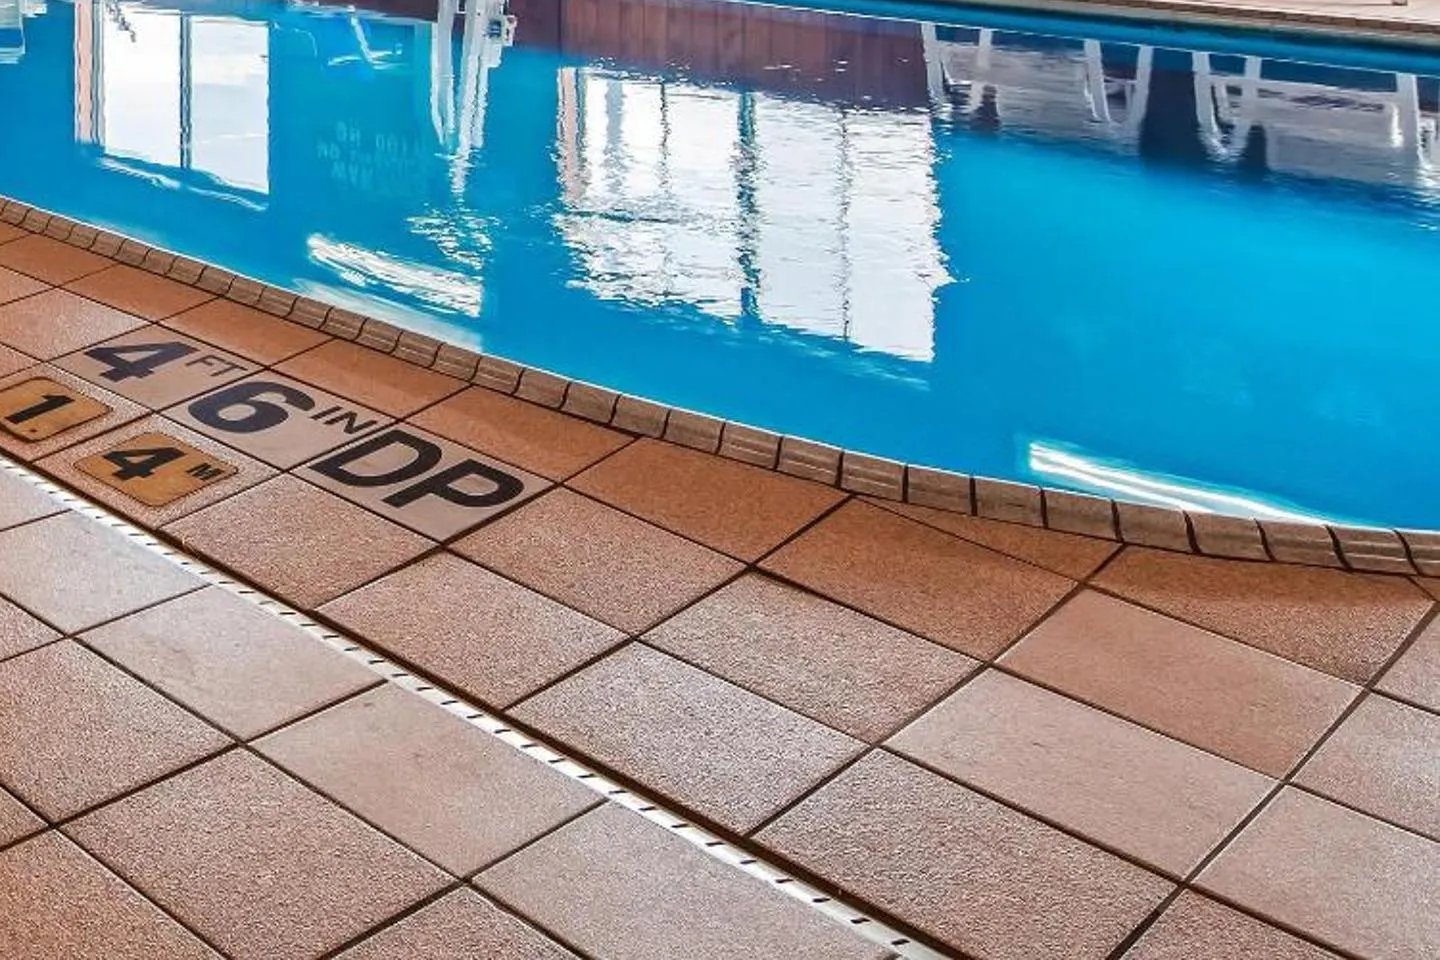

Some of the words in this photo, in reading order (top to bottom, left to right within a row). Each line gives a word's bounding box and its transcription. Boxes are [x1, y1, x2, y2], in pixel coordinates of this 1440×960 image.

[84, 341, 201, 382] 4
[185, 355, 248, 377] FT
[188, 381, 315, 433] 6
[310, 405, 377, 434] IN
[102, 446, 188, 481] 4
[185, 462, 223, 481] M
[310, 429, 525, 508] DP
